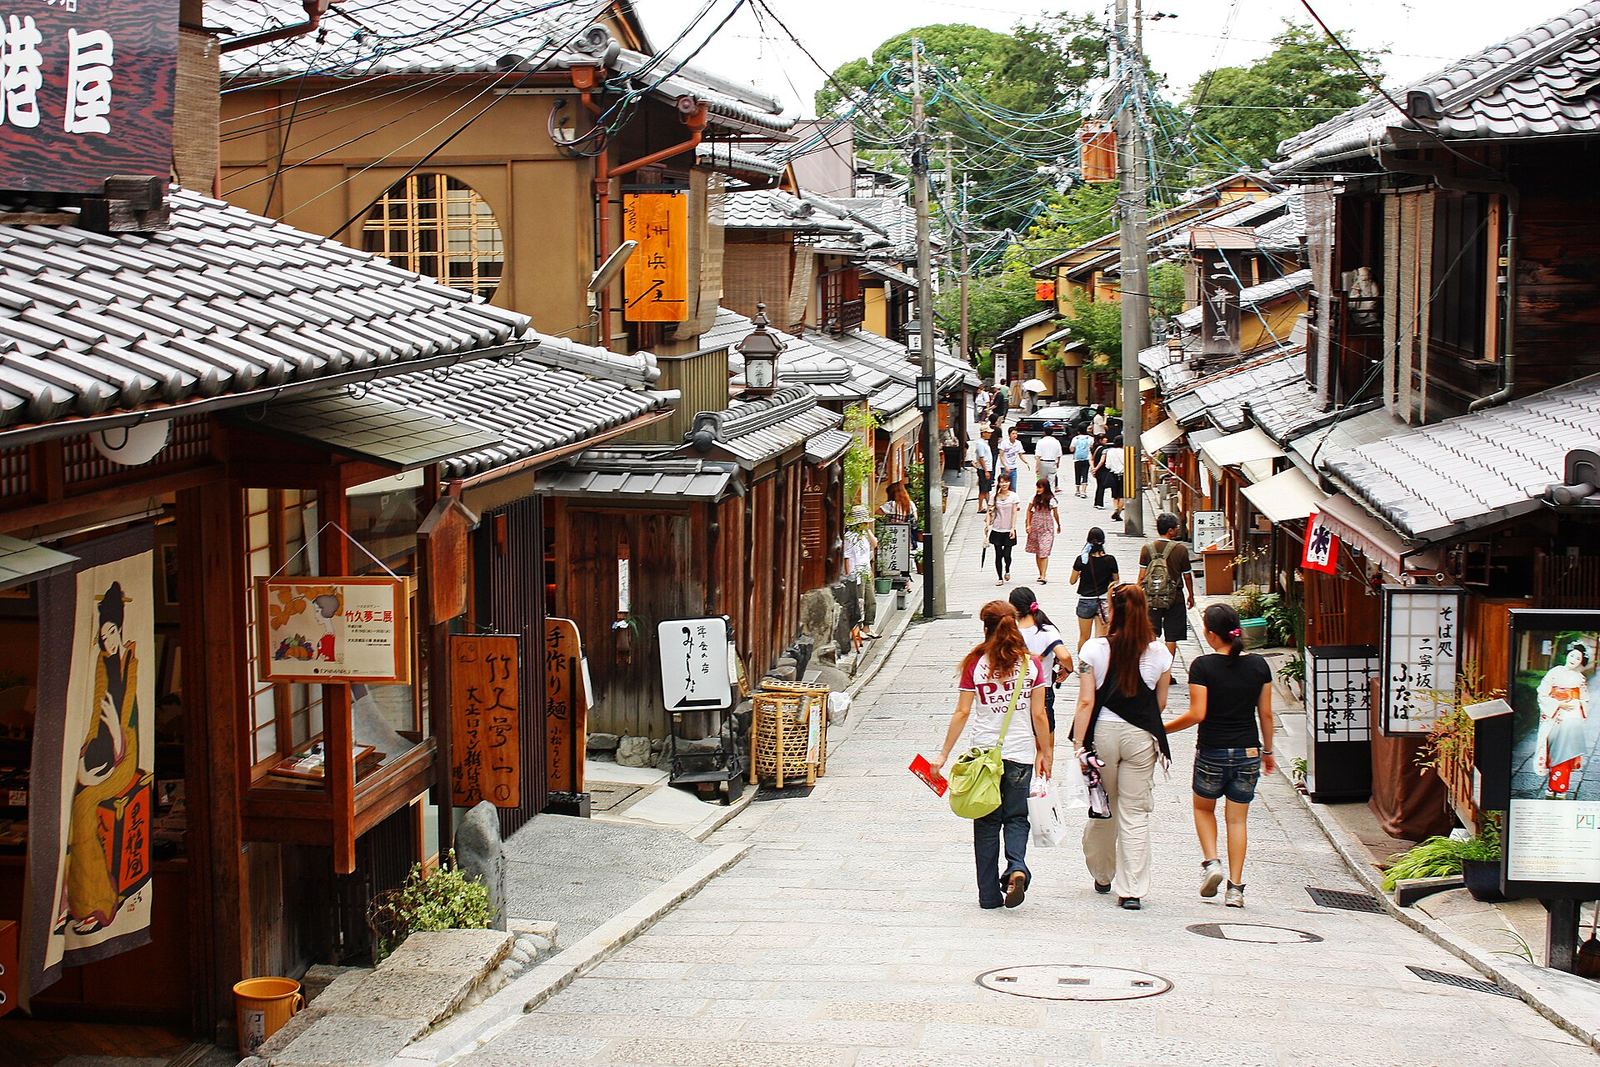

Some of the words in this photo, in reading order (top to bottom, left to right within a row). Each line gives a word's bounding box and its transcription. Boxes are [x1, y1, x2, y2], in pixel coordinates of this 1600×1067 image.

[345, 610, 393, 623] 竹久夢二展
[1436, 606, 1454, 658] そば処
[545, 626, 568, 720] 手作り麺
[1416, 638, 1434, 689] 二寧坂
[485, 652, 517, 774] 竹久夢二
[991, 702, 1027, 713] WOLD
[1322, 687, 1341, 734] ふたば
[1392, 663, 1415, 720] ふたば
[550, 728, 562, 780] 小松うどん
